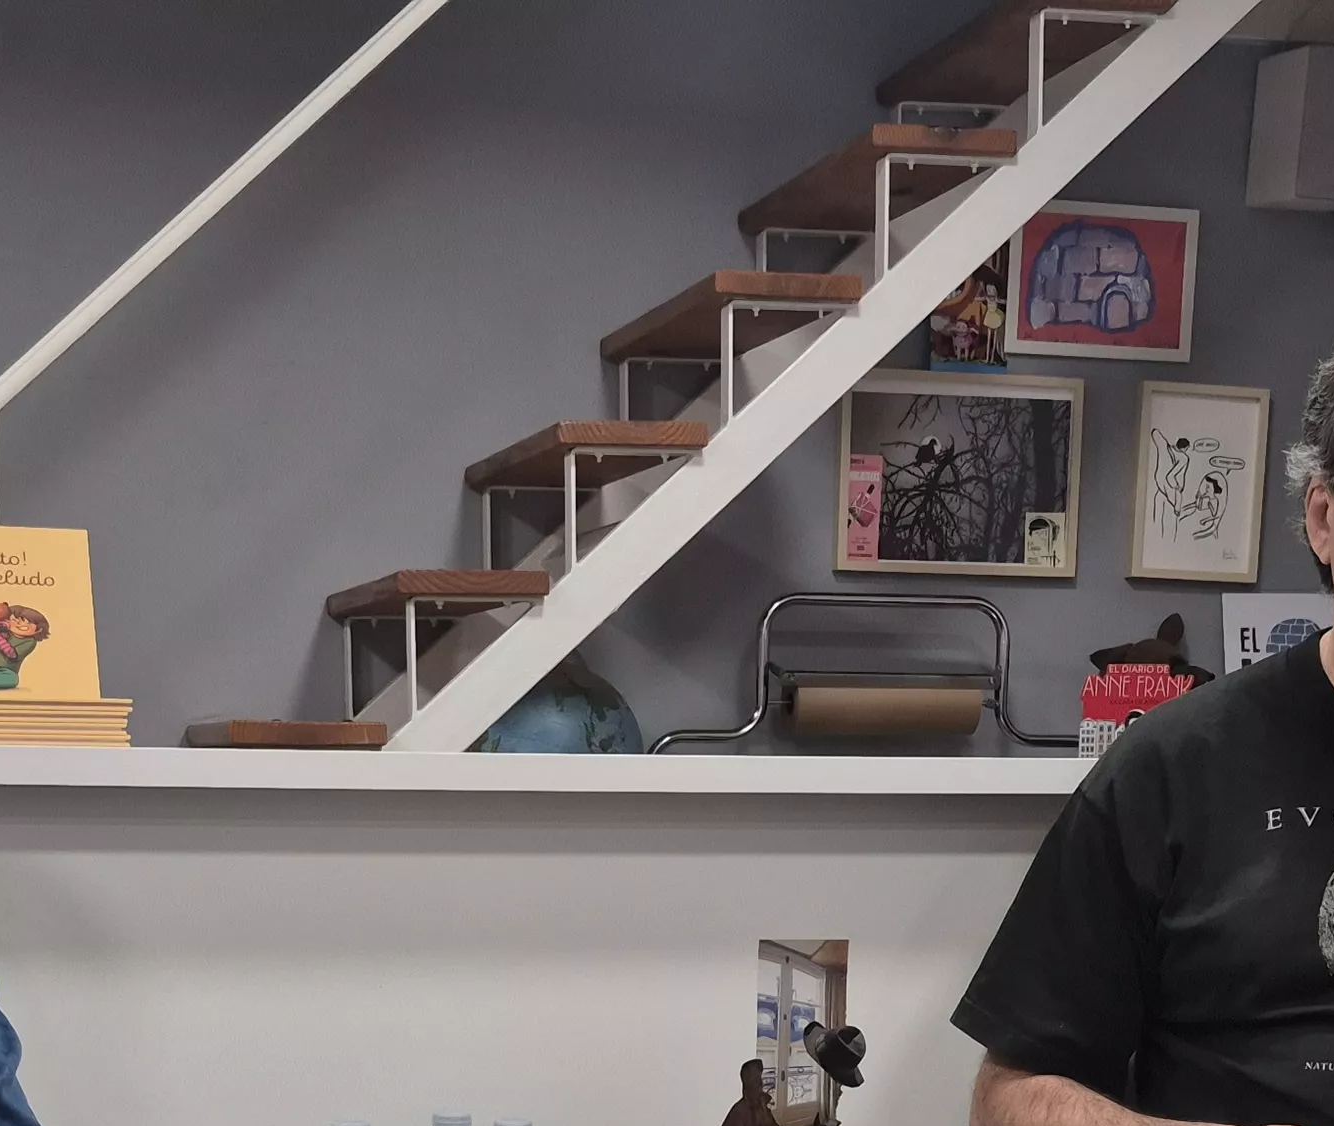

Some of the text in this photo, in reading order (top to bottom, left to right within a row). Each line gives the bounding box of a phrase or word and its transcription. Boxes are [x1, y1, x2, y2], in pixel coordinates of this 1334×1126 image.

[1240, 626, 1261, 654] EL
[1109, 664, 1170, 674] EL DIARIO DE
[1081, 674, 1195, 698] ANNE FRANK
